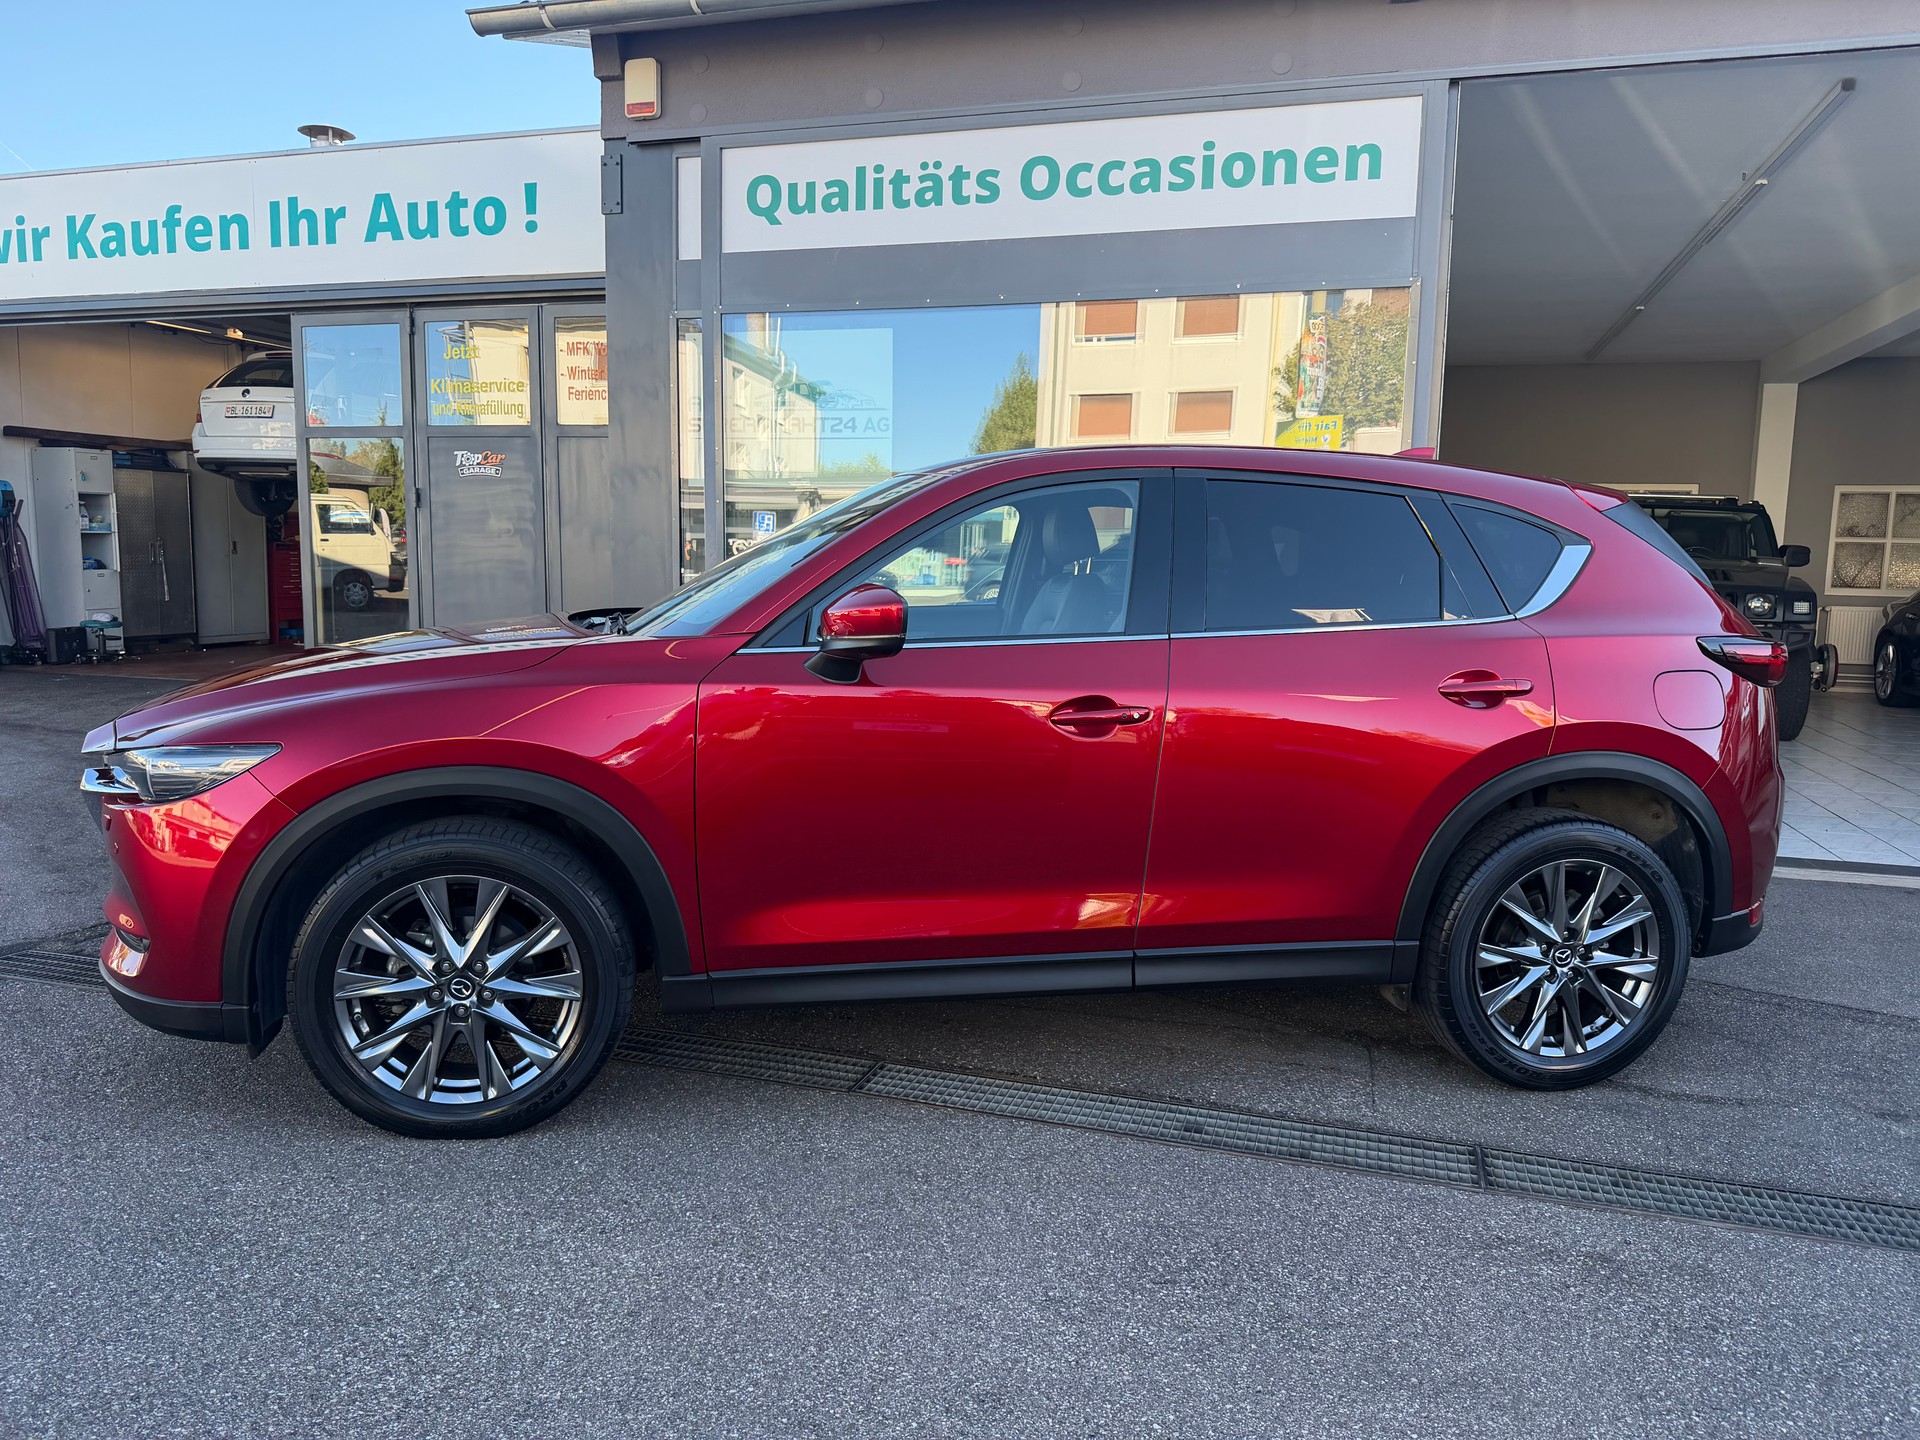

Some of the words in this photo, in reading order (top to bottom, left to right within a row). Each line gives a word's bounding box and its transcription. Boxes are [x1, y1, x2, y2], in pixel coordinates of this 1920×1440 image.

[745, 160, 1001, 226] Qualitäts
[1019, 140, 1383, 201] Occasionen
[66, 204, 250, 260] Kaufen
[269, 196, 347, 248] Ihr
[363, 191, 508, 243] Auto
[443, 345, 479, 360] Jetzt
[431, 377, 525, 394] Klimaservice
